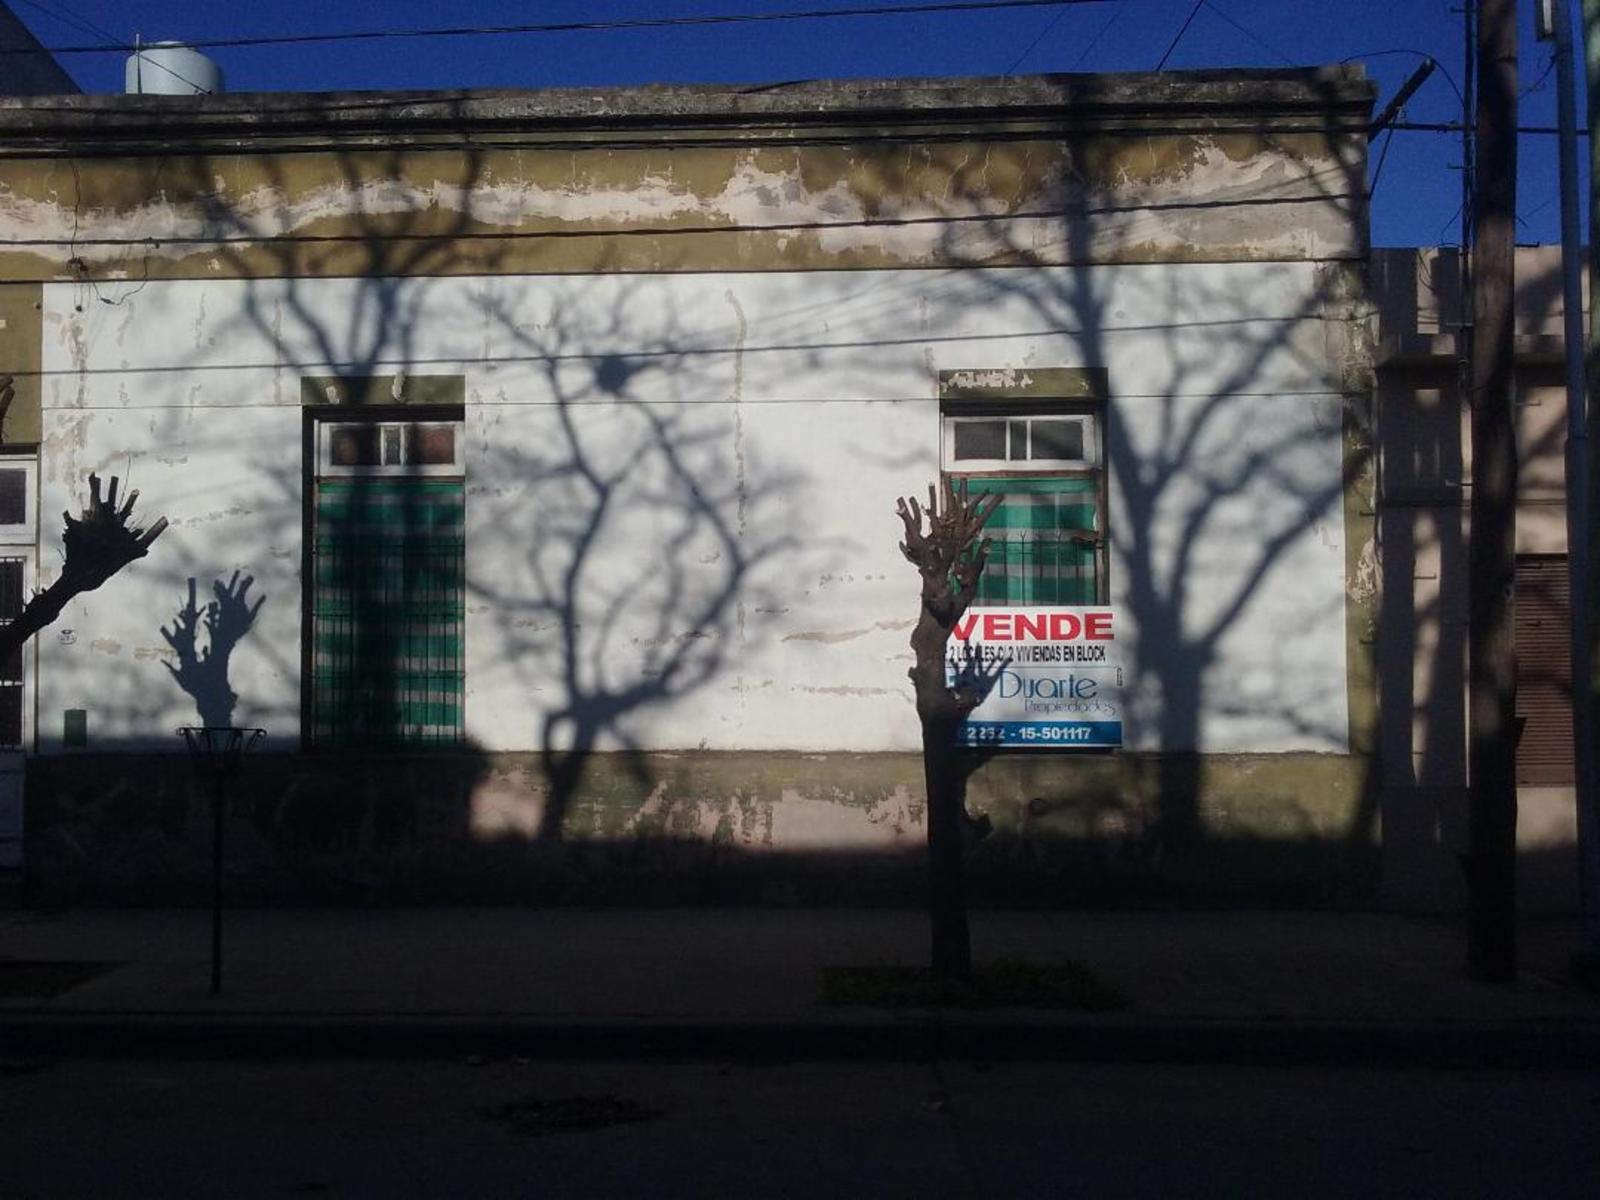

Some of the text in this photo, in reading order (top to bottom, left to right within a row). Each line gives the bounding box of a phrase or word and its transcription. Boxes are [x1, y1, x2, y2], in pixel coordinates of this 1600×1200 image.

[952, 613, 1115, 641] VENDE
[1016, 645, 1062, 662] VIVIENDAS
[1063, 645, 1075, 662] EN
[1076, 645, 1106, 662] BLOCK
[999, 670, 1097, 700] Duarte
